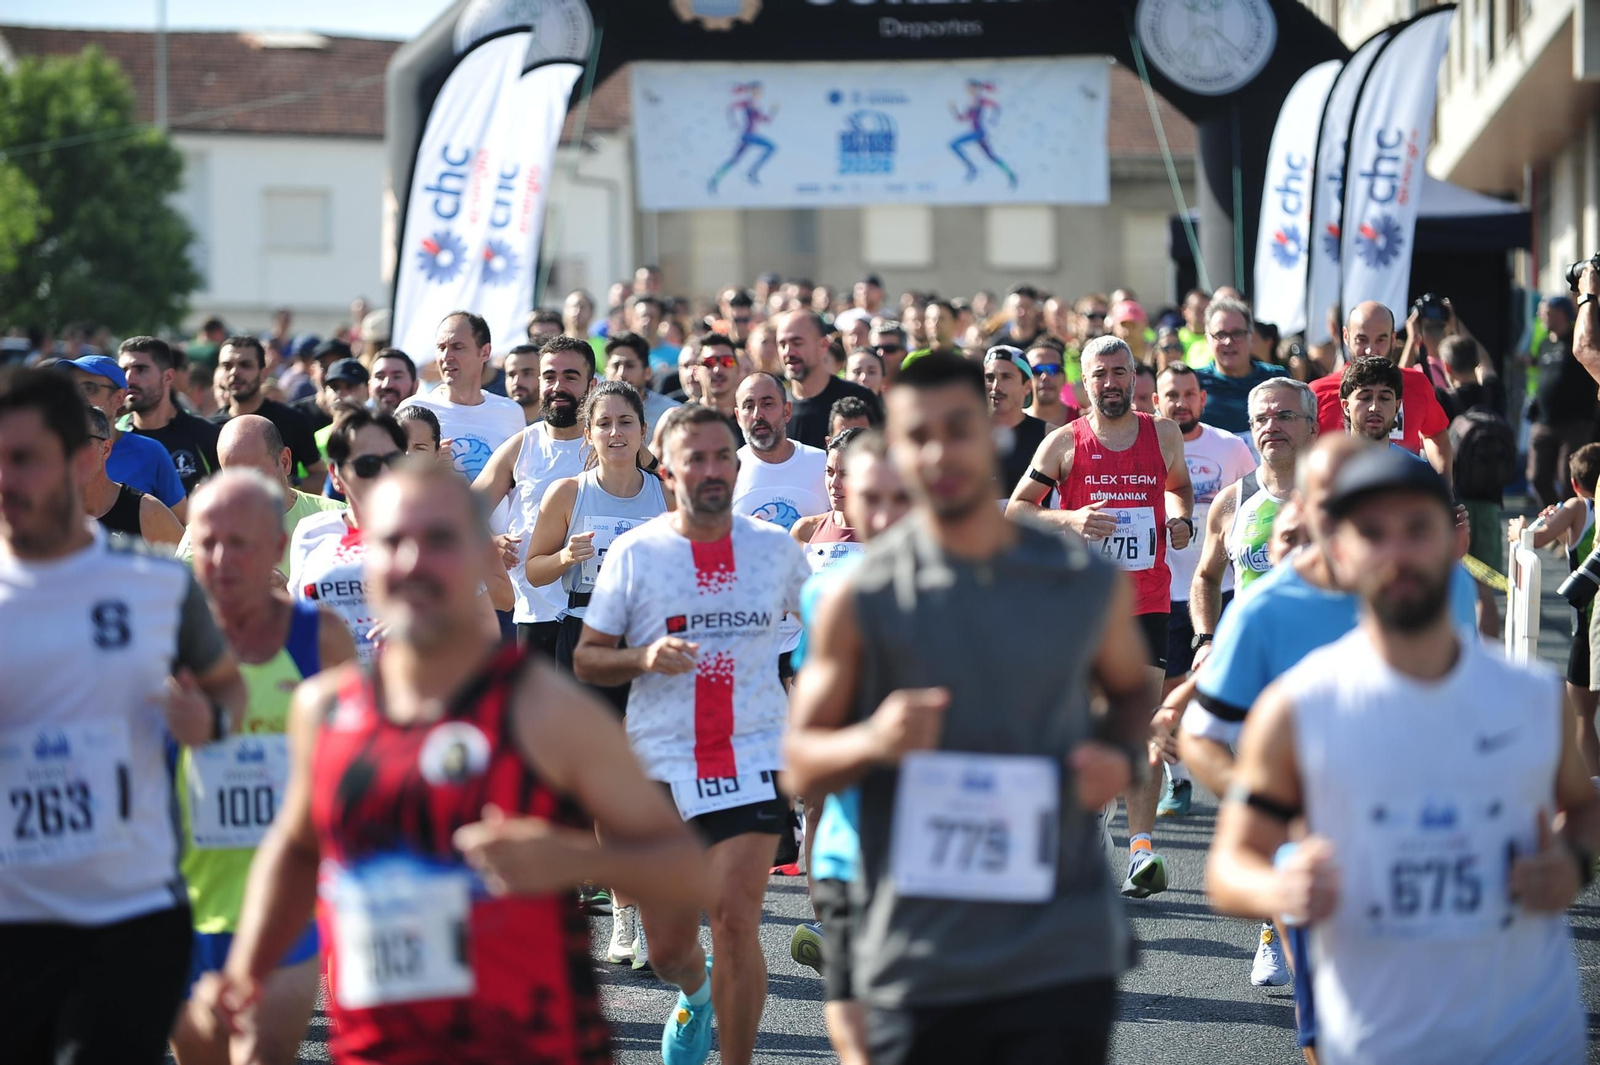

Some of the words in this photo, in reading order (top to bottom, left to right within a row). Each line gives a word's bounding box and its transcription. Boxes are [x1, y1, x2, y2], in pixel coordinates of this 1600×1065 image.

[424, 144, 470, 219] chc
[1275, 151, 1306, 215] chc
[1360, 129, 1403, 202] chc
[1084, 474, 1118, 485] ALEX
[1121, 474, 1157, 485] TEAM
[1090, 489, 1147, 501] RUNMANIAK
[1100, 536, 1138, 560] 476
[690, 610, 772, 629] PERSAN
[9, 780, 93, 840] 263
[217, 786, 274, 827] 100
[1390, 857, 1482, 916] 675
